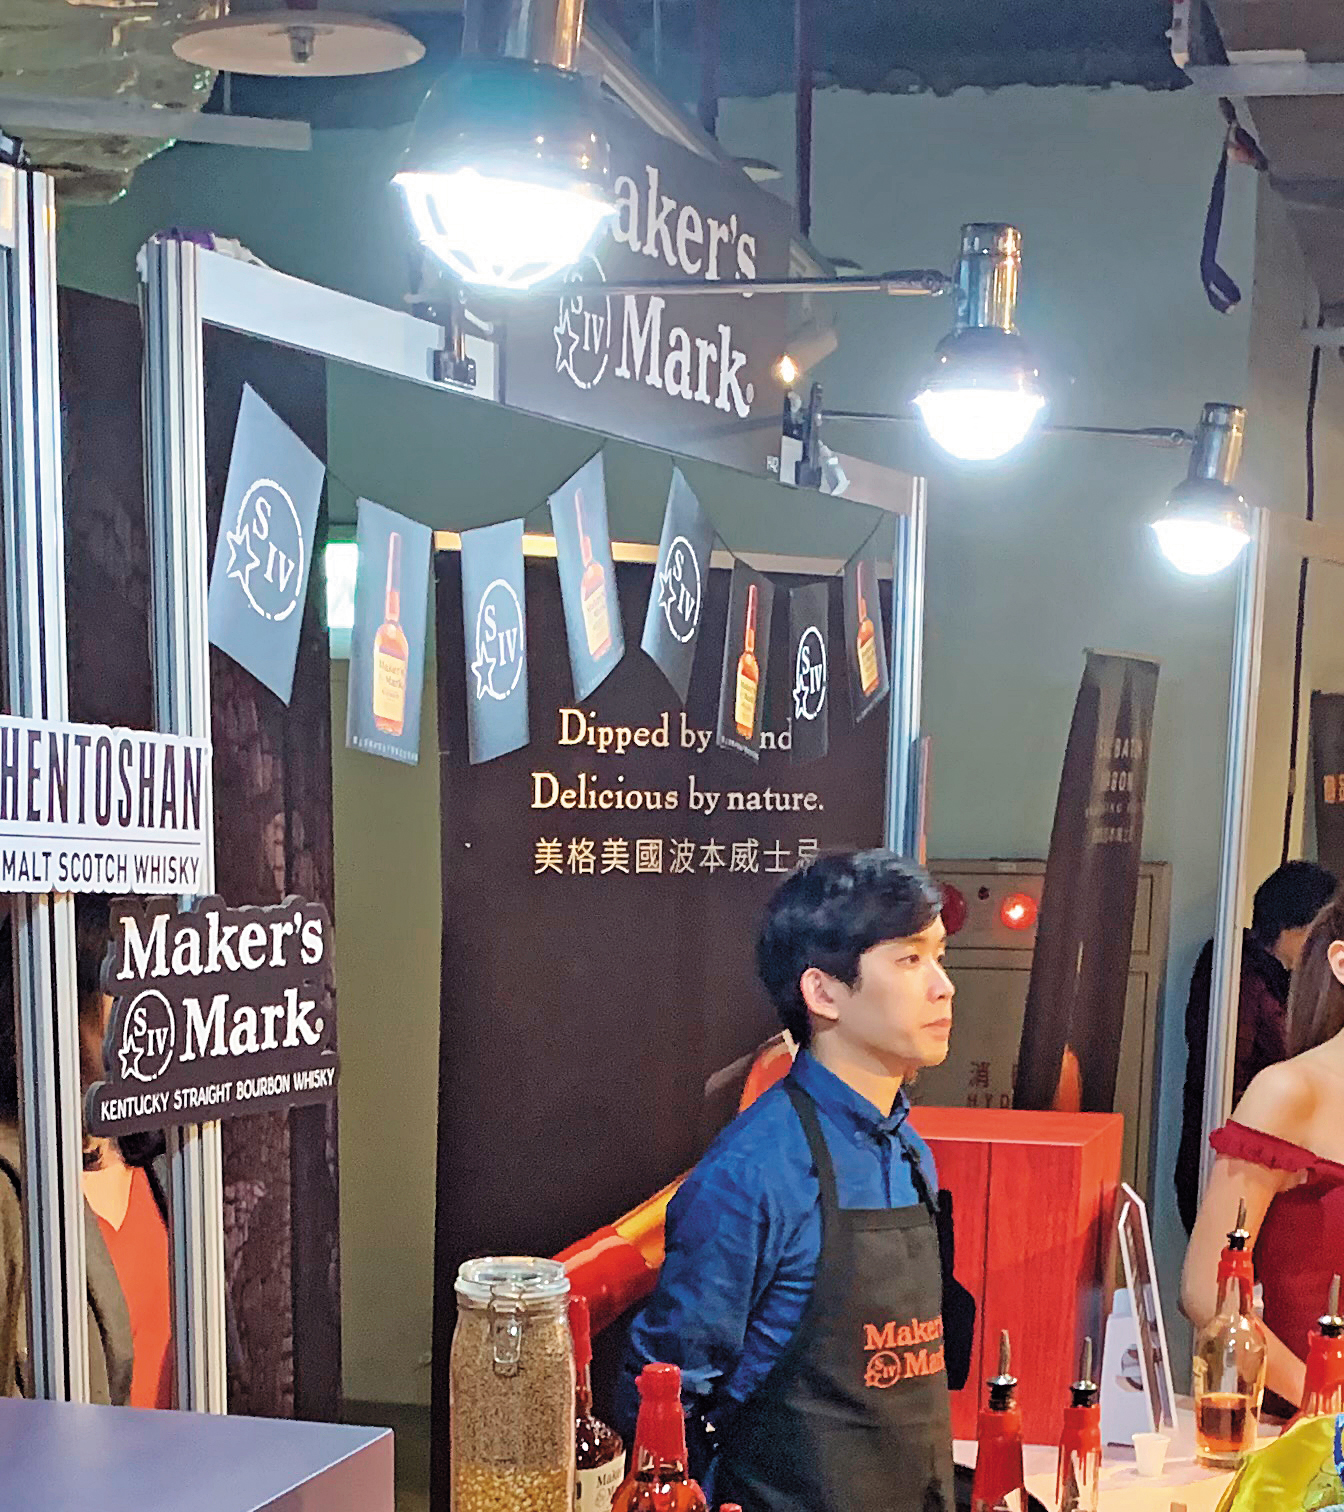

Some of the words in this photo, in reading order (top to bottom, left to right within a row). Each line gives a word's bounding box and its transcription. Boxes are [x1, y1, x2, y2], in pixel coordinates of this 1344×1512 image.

[609, 164, 756, 297] aker's
[558, 708, 669, 753] Dipped
[680, 712, 712, 752] by
[530, 772, 678, 810] Delicious
[688, 775, 720, 815] by
[726, 787, 824, 811] nature.
[2, 850, 51, 883] MALT
[58, 852, 128, 885] SCOTCH
[134, 854, 200, 886] WHISKY
[116, 910, 324, 981] Maker's
[101, 1092, 169, 1122] KENTUCKY
[173, 1085, 233, 1112] STRAIGHT
[236, 1075, 290, 1101] BOURBON
[293, 1067, 335, 1094] WHISKY
